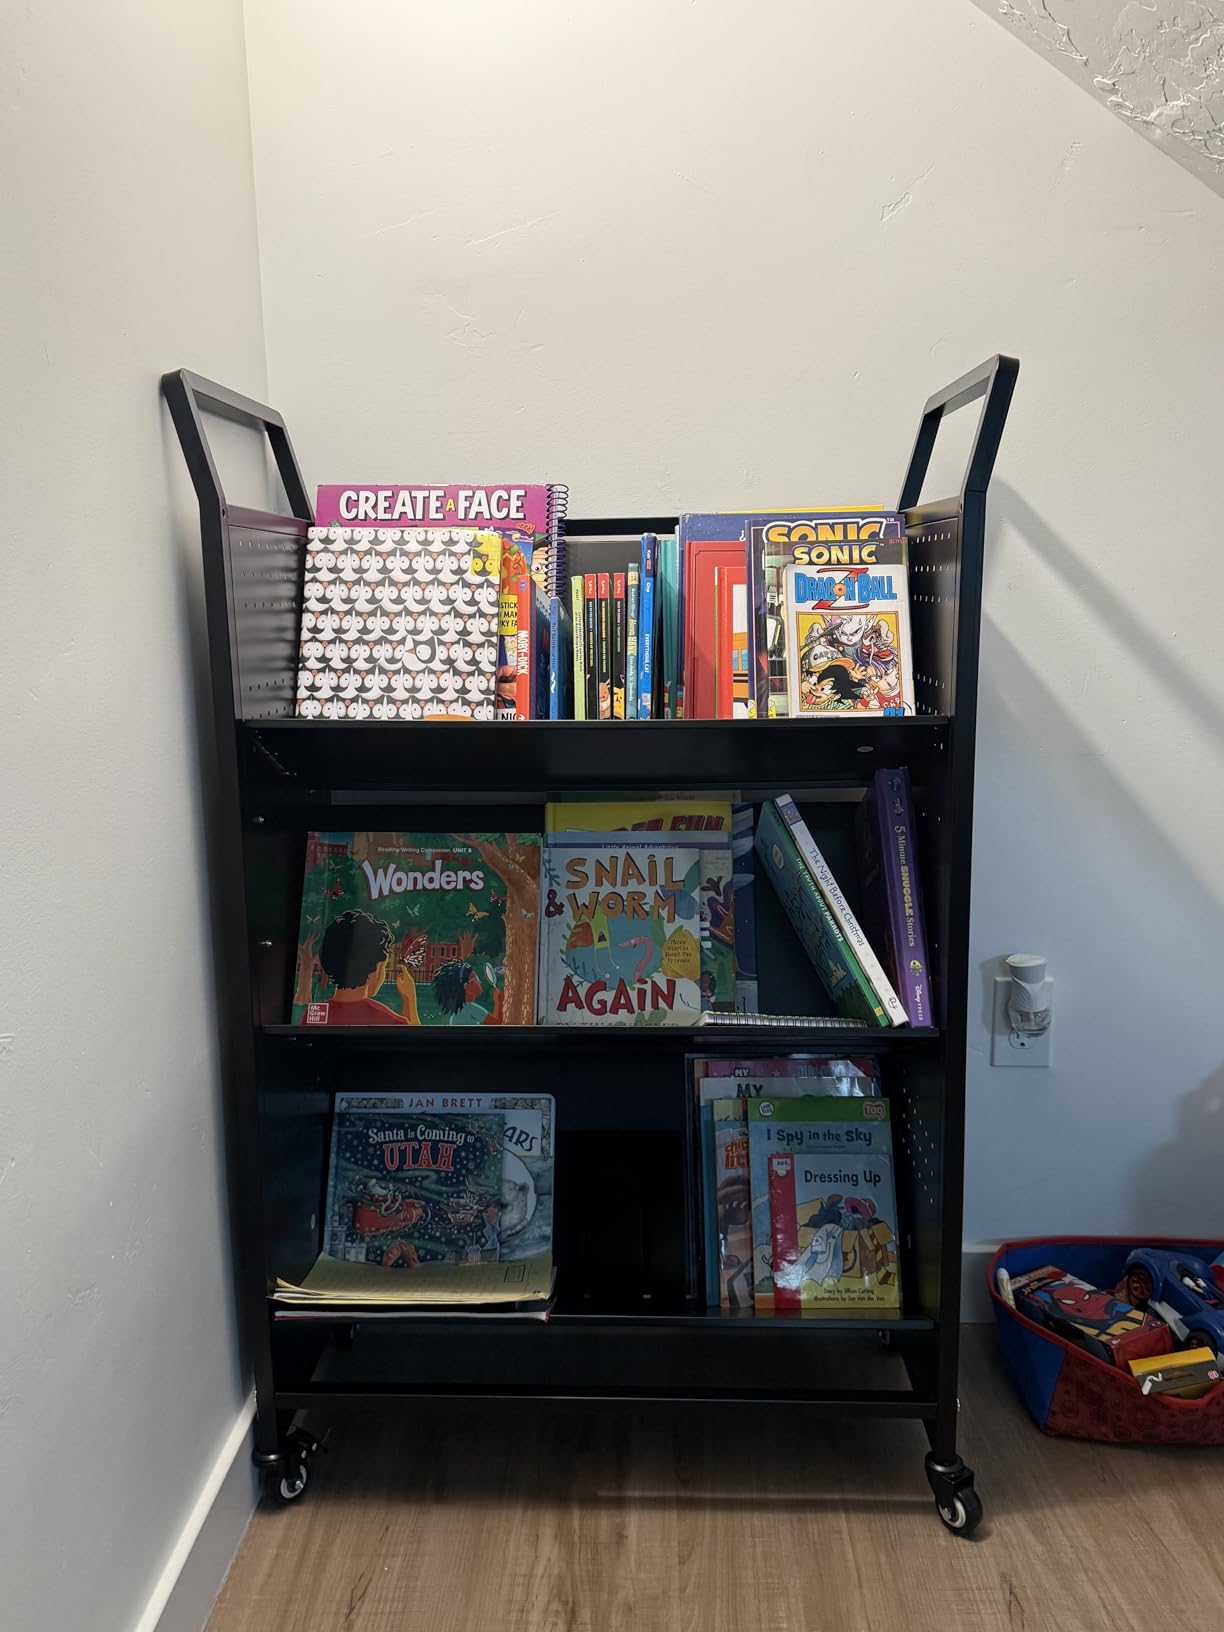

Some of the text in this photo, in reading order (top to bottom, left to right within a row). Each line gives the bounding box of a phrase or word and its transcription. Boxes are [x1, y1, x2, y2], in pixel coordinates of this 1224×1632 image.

[339, 489, 527, 520] CREATE A FACE
[793, 543, 878, 564] SONIC
[794, 572, 898, 603] DRAGON BALL
[517, 630, 528, 676] MOBY-DICK
[362, 860, 485, 900] Wonders
[901, 865, 914, 916] SNUGGLE
[544, 889, 676, 924] & WORM
[809, 848, 865, 947] The Night Before Christmas
[823, 908, 844, 942] PARROTS
[906, 917, 916, 947] Stories
[408, 1098, 482, 1108] JAN BRETT
[736, 1083, 763, 1098] MY
[368, 1124, 475, 1146] Santa is Coming to
[767, 1128, 771, 1140] I
[776, 1129, 804, 1146] Spy
[808, 1128, 820, 1140] in
[824, 1130, 841, 1141] the
[845, 1128, 872, 1147] Sky
[382, 1142, 456, 1172] UTAH
[804, 1170, 881, 1187] Dressing Up
